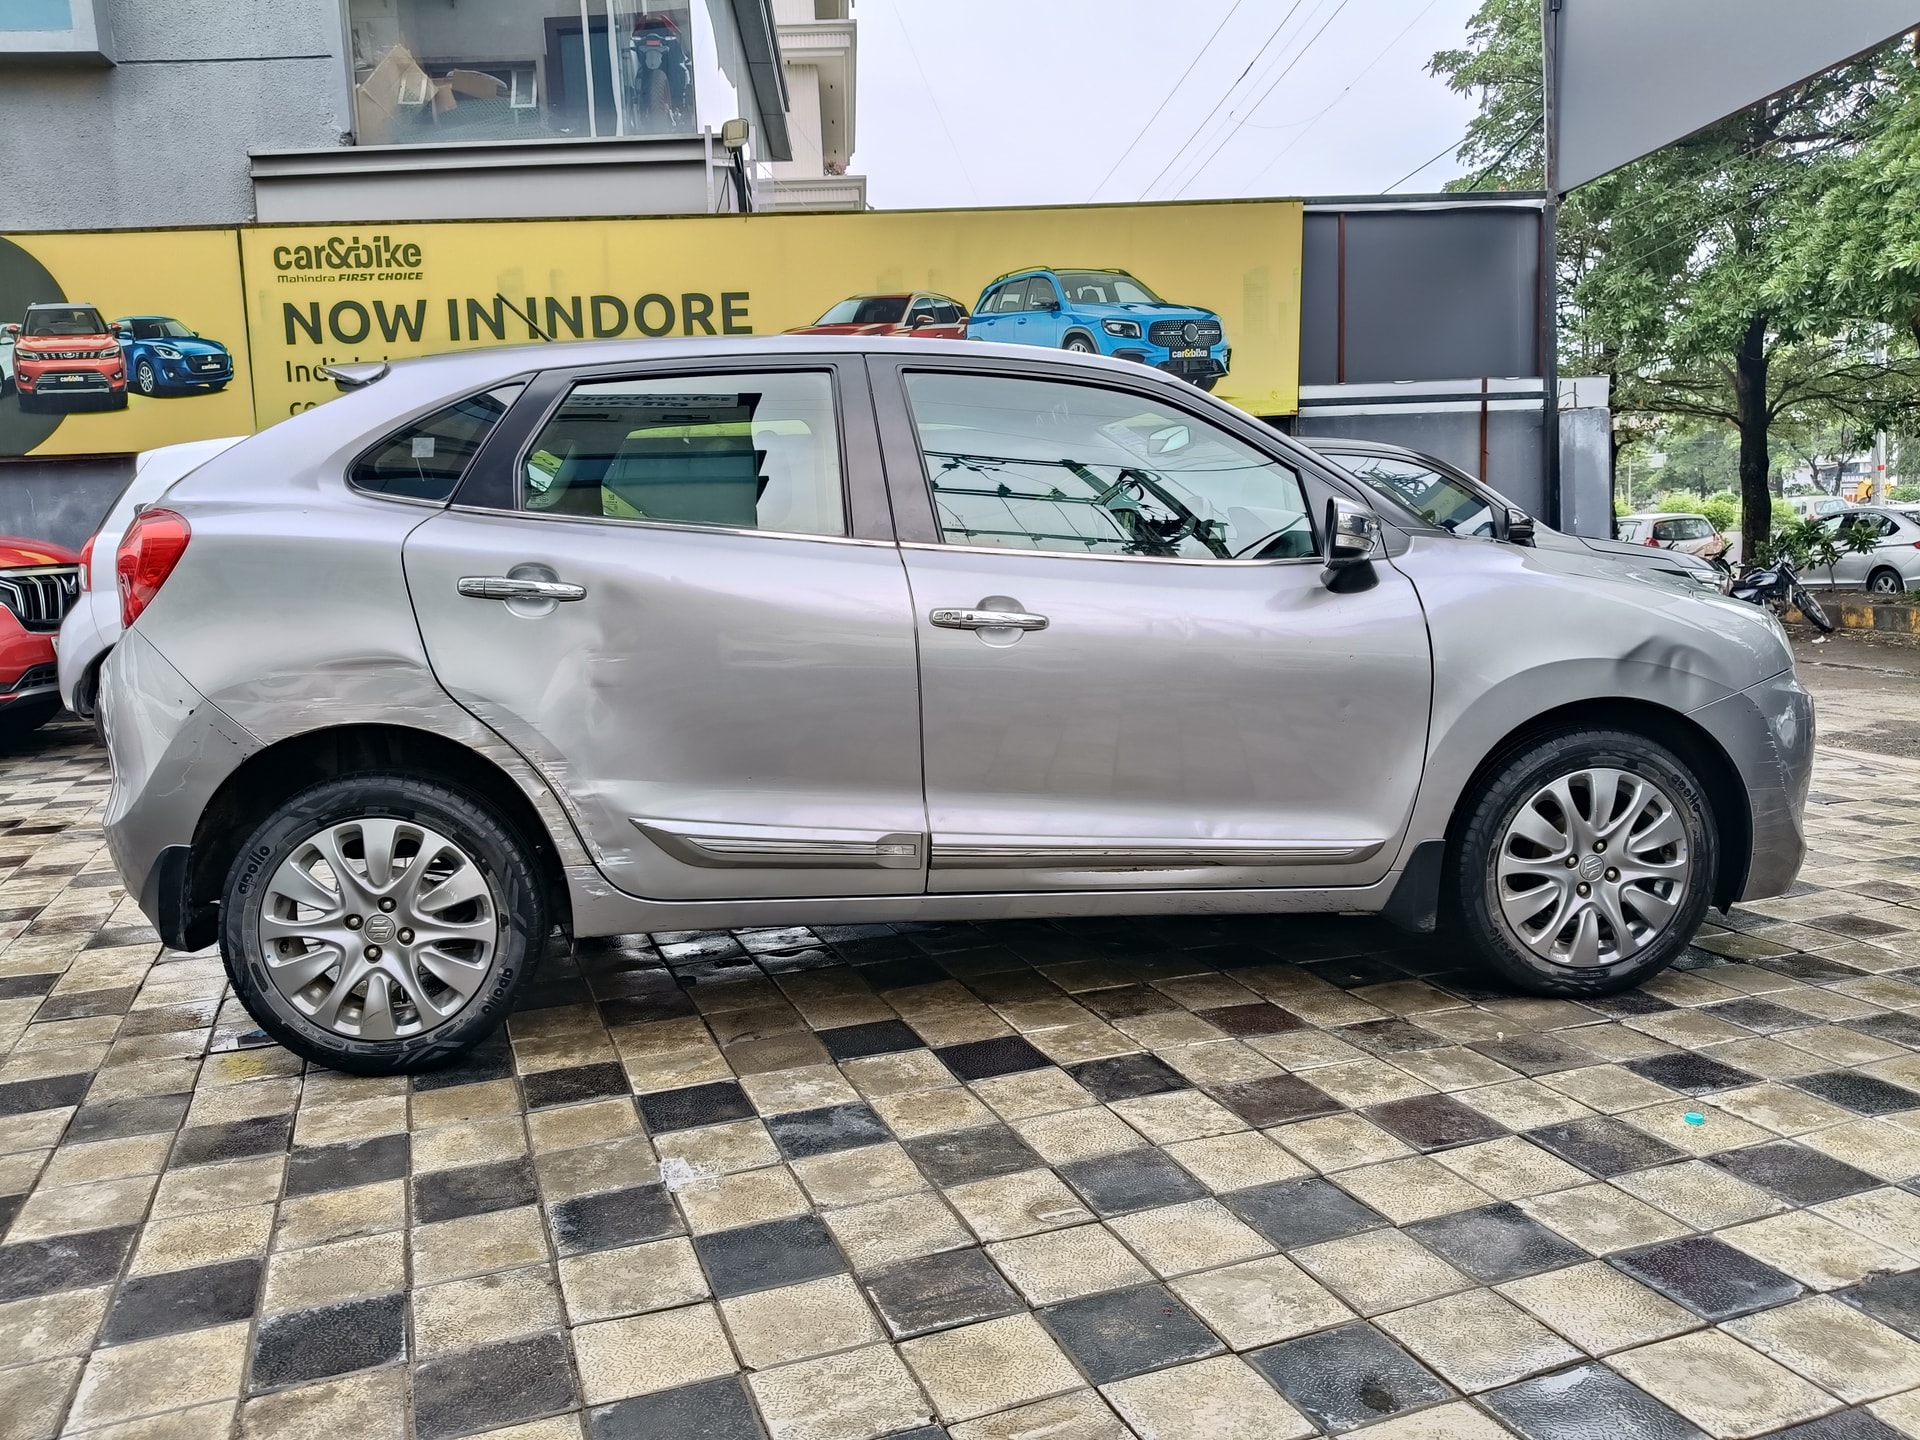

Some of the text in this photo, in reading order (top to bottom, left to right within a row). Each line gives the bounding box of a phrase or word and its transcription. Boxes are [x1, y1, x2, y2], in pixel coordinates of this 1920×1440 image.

[273, 235, 422, 270] car&bike
[277, 272, 423, 283] Mahindra FIRST CHOICE
[283, 291, 753, 345] NOW IN INDORE
[1171, 348, 1208, 358] car&bike
[1669, 774, 1701, 813] apollo
[237, 845, 271, 892] apollo
[481, 967, 514, 1015] apollo
